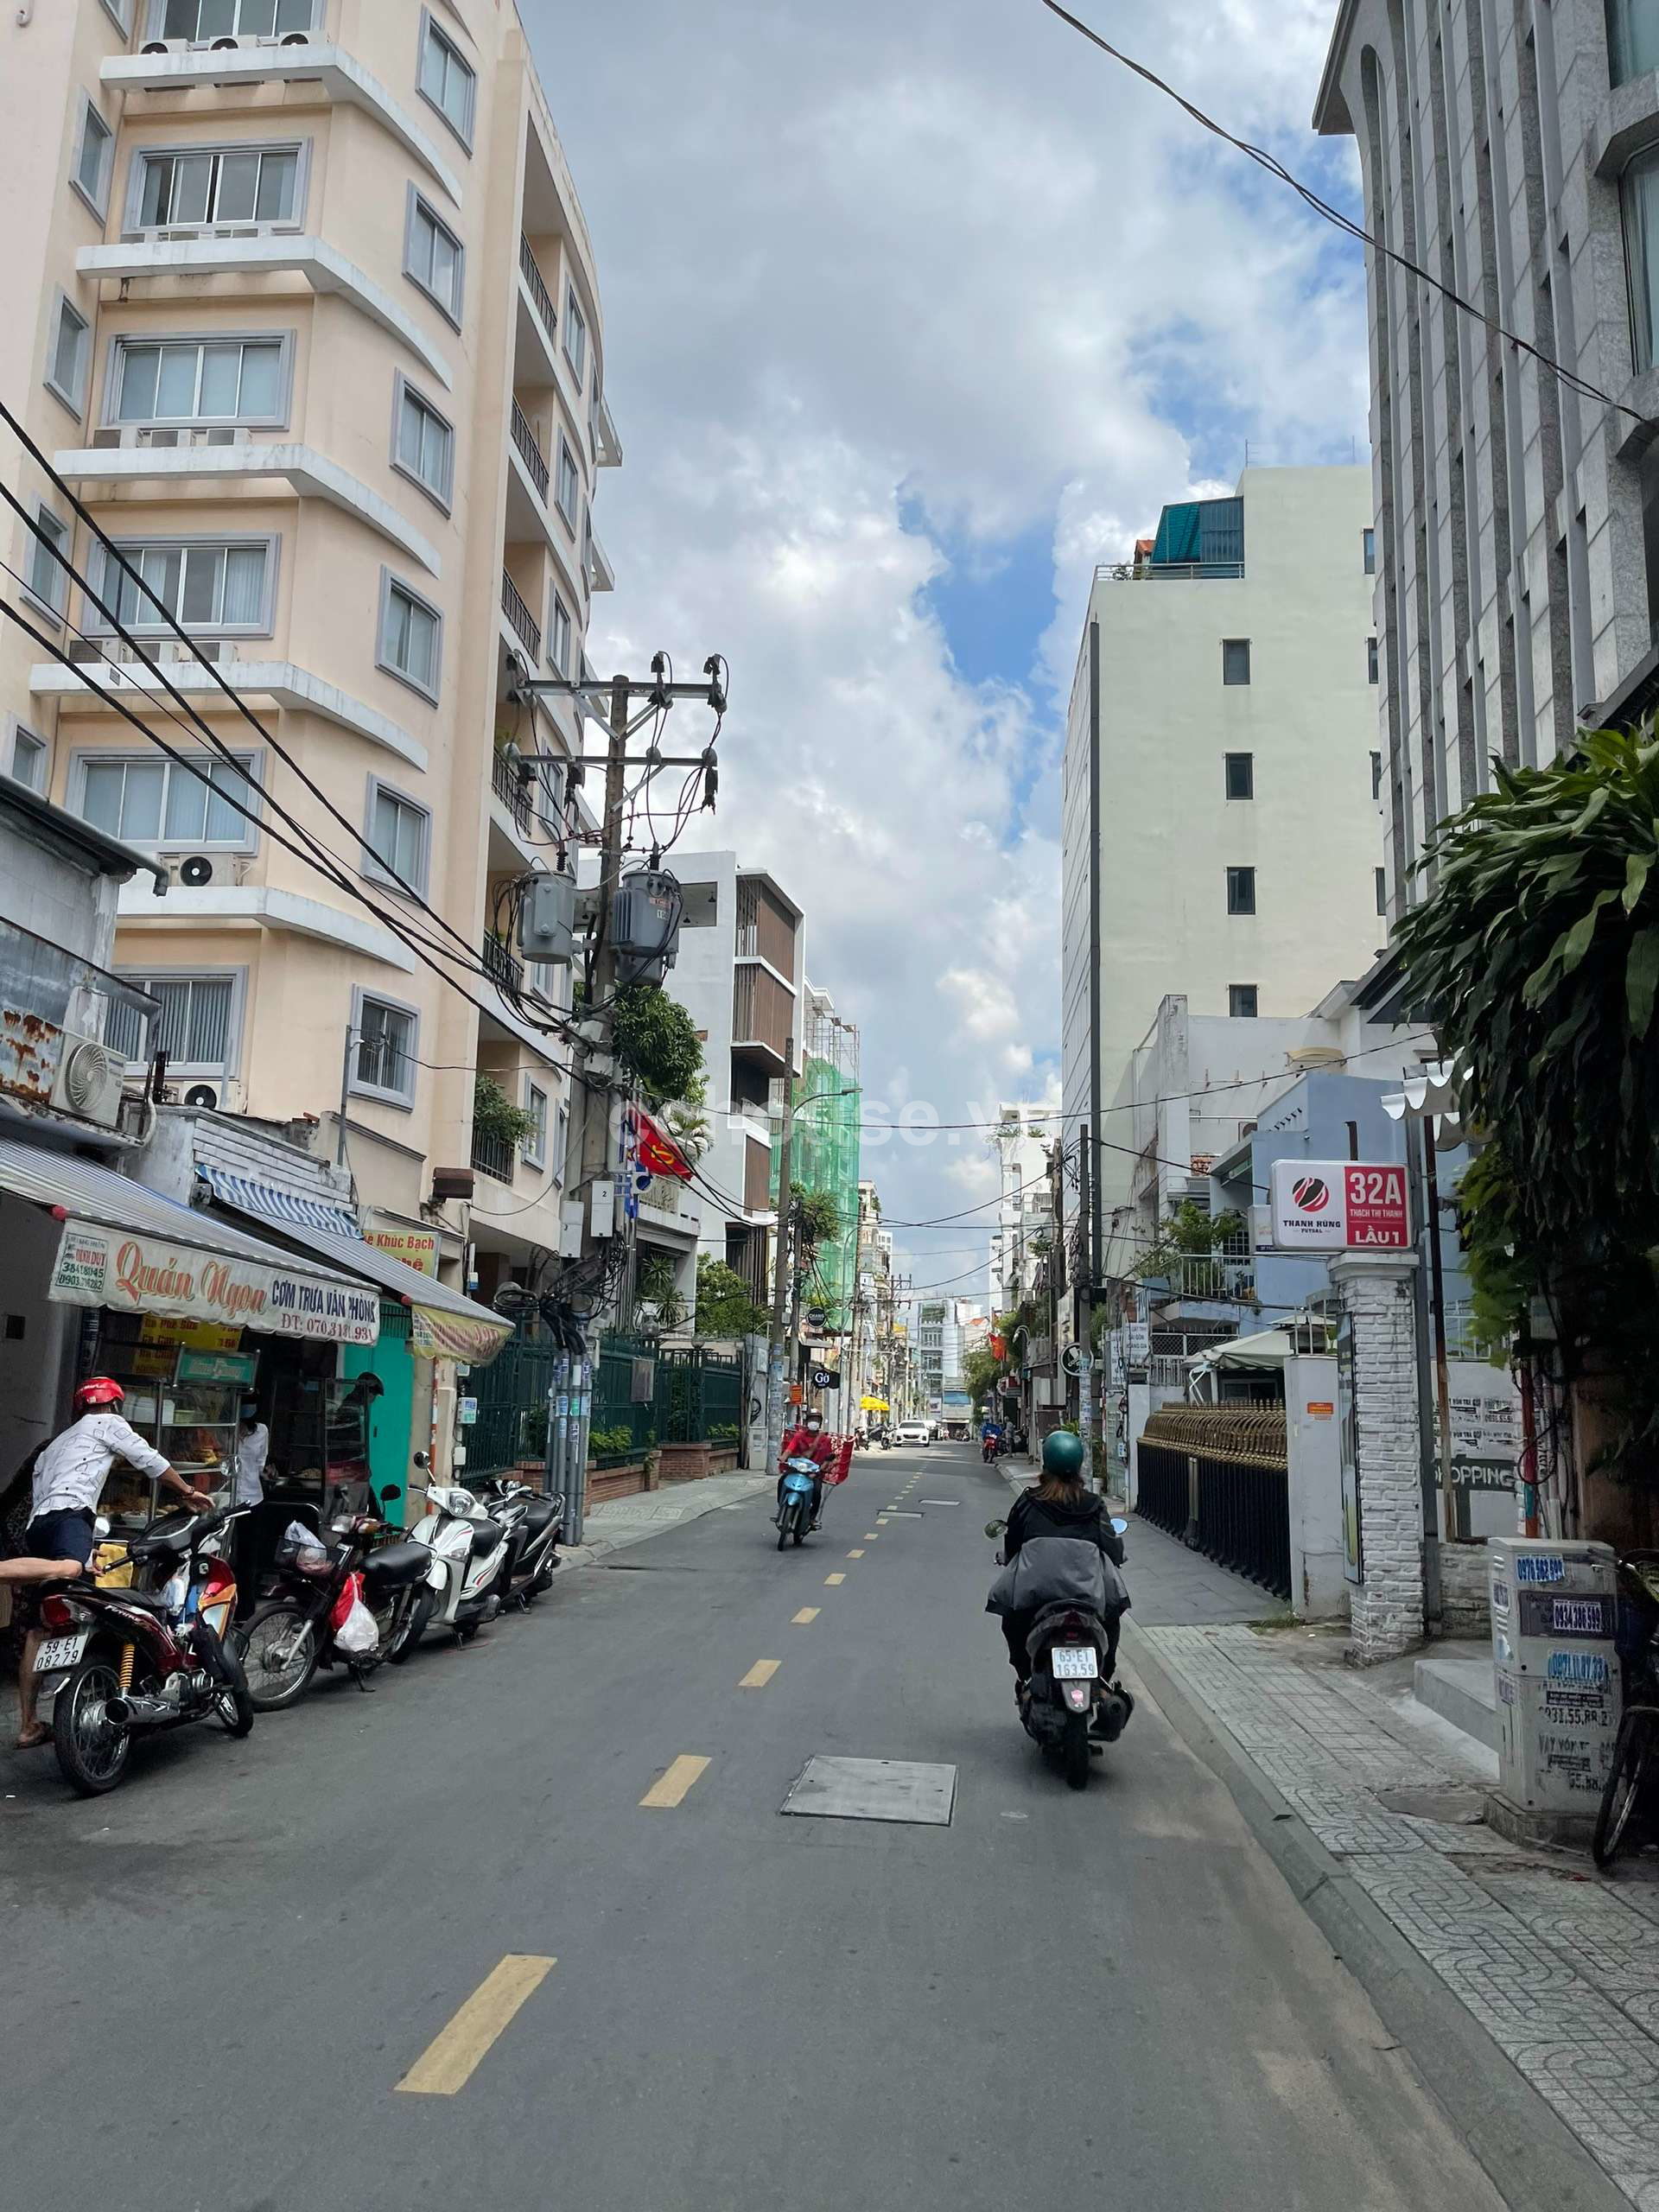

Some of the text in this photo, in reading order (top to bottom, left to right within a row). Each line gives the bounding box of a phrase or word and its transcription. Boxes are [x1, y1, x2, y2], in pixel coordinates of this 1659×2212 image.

[1350, 1173, 1402, 1205] 32A
[1282, 1218, 1341, 1228] THANH HÙNG
[377, 1234, 404, 1249] Khúc
[407, 1236, 435, 1251] Bạch
[1355, 1224, 1399, 1244] LẦU 1
[115, 1242, 267, 1319] Quán Ngon
[271, 1280, 296, 1309] CƠM
[299, 1285, 324, 1314] TRƯA
[326, 1289, 346, 1318] VĂN
[45, 1637, 78, 1654] 59-E1
[1057, 1664, 1095, 1676] 163.59
